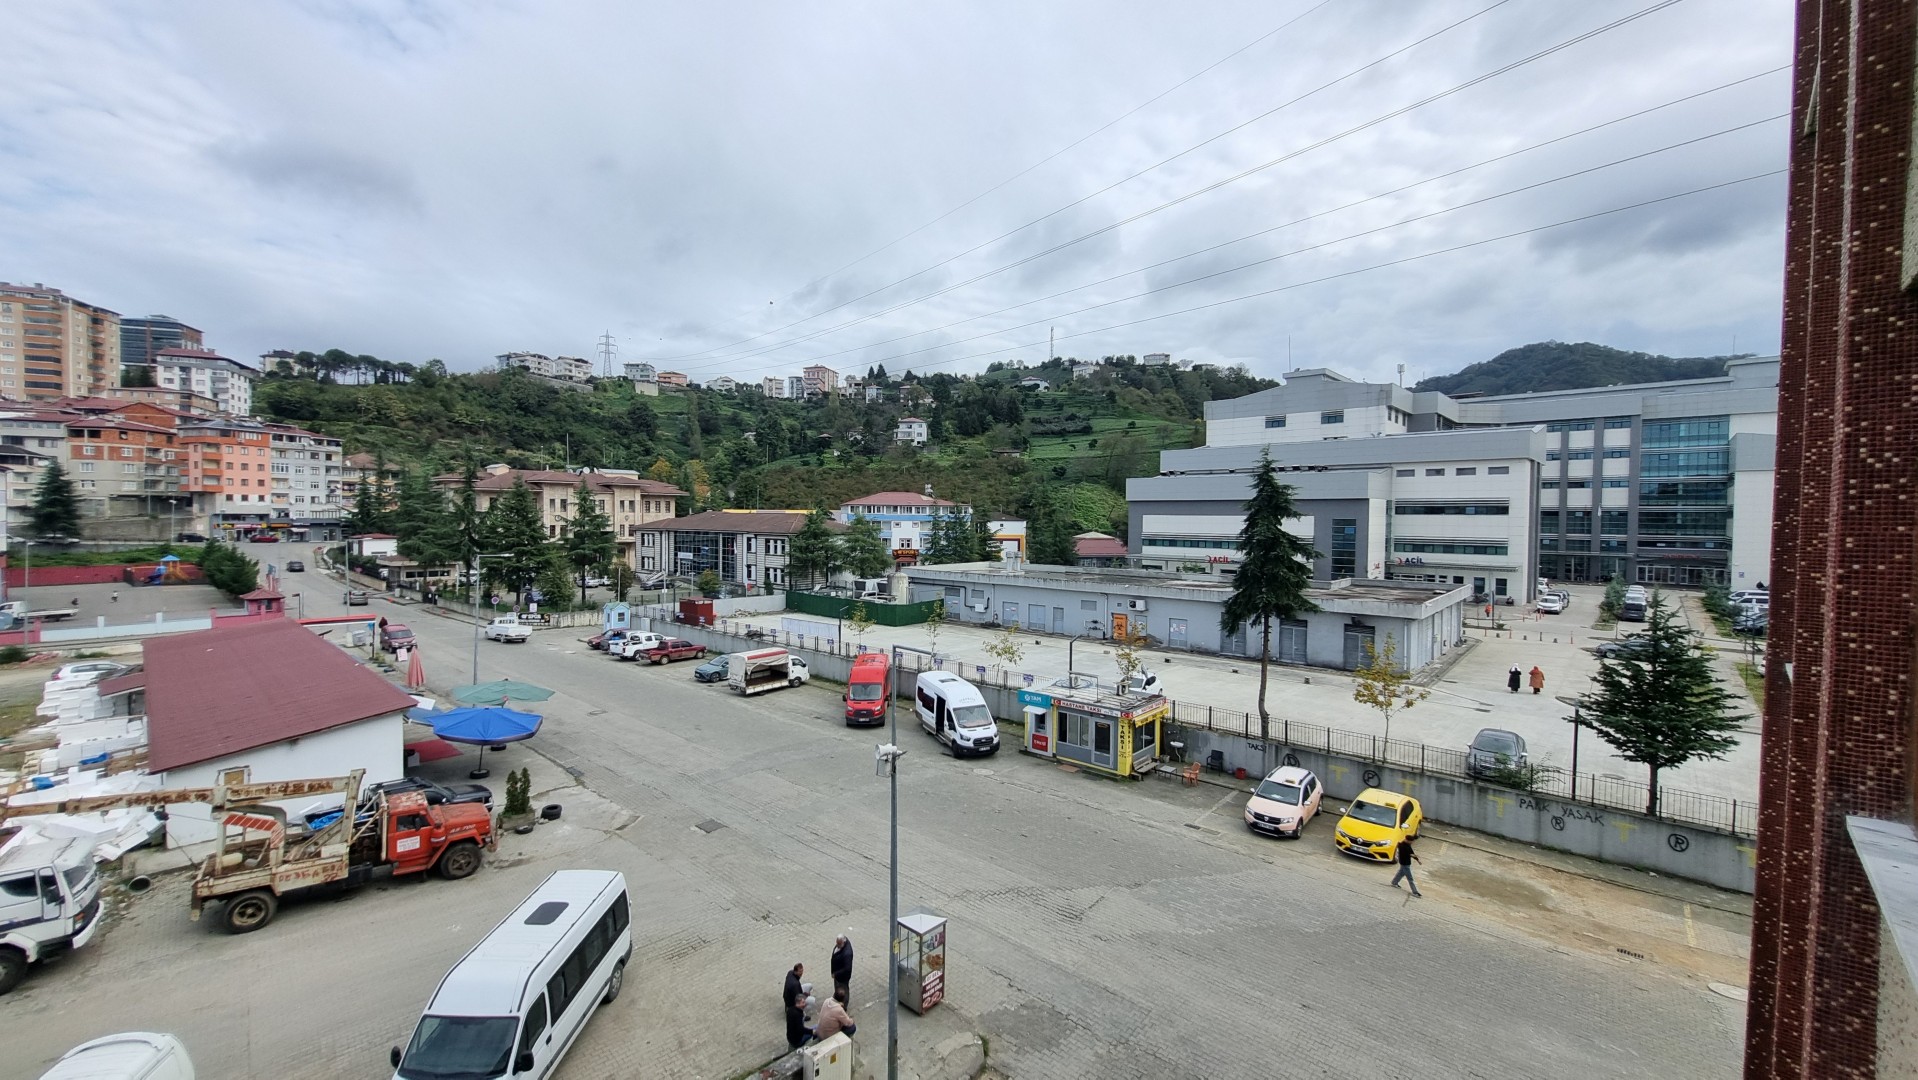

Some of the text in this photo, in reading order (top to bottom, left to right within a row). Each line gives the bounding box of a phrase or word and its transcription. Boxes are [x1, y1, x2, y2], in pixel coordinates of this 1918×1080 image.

[1404, 556, 1424, 564] ACİL
[1519, 798, 1605, 827] PARK YASAK
